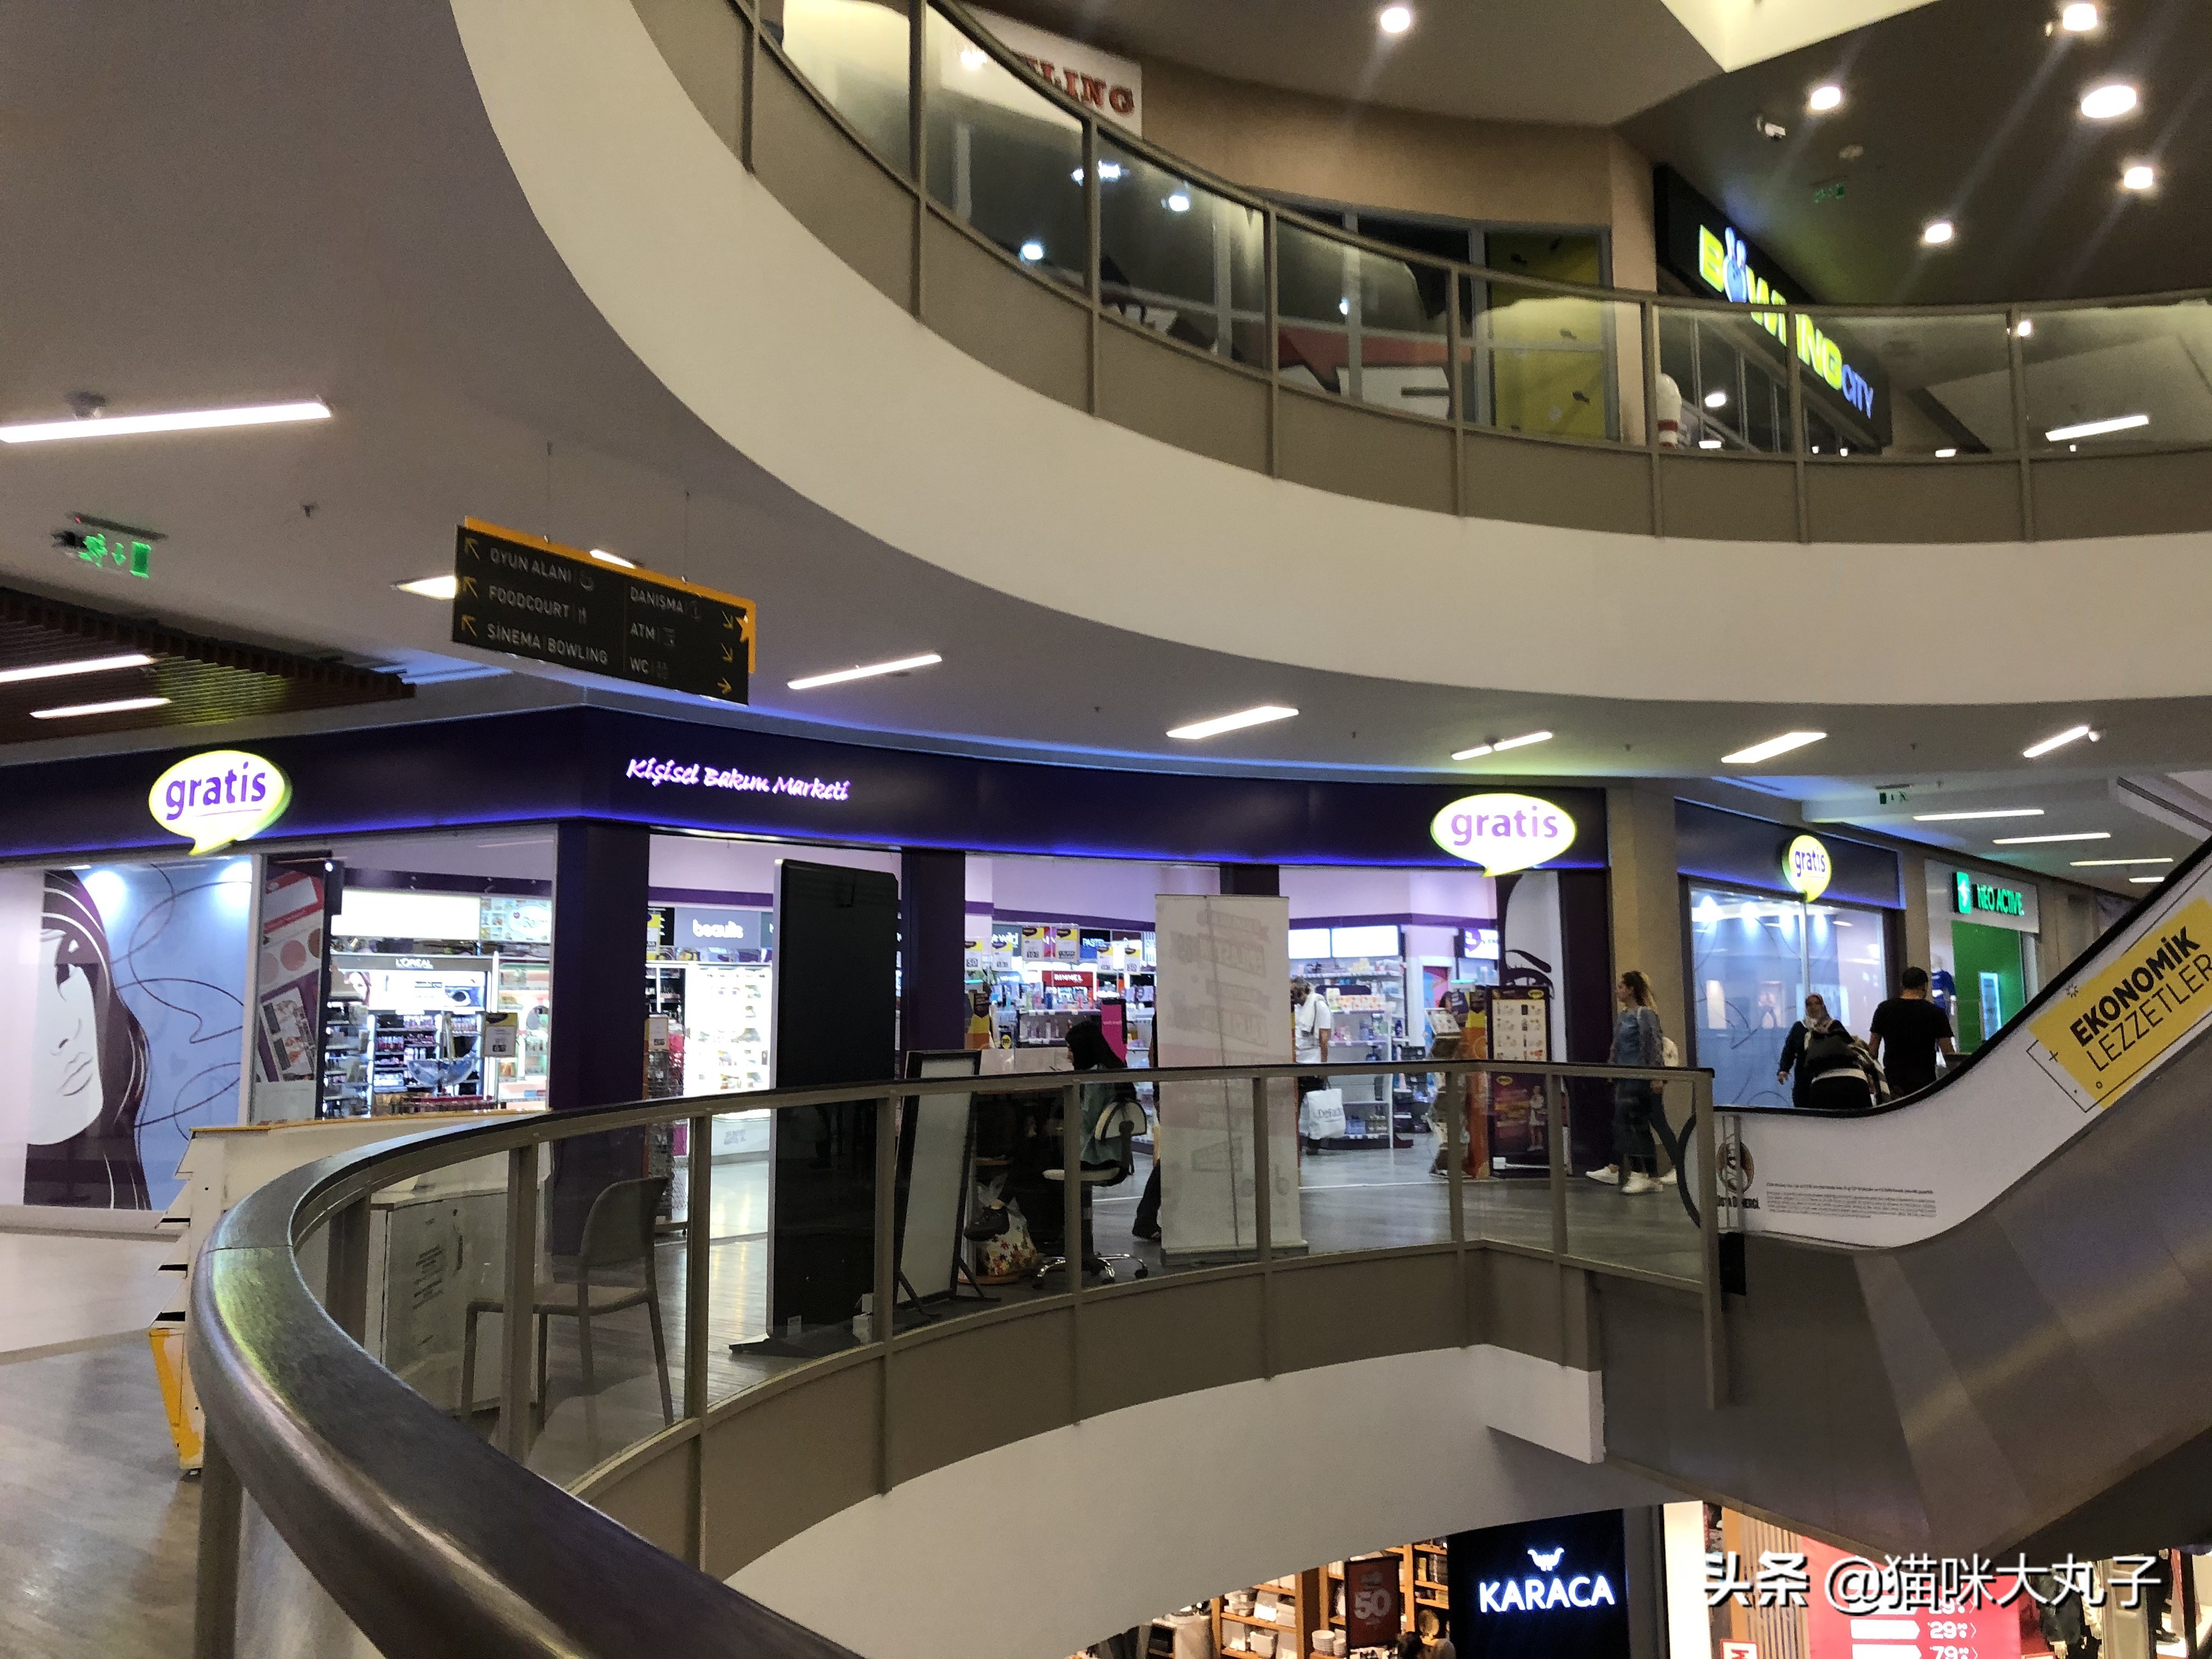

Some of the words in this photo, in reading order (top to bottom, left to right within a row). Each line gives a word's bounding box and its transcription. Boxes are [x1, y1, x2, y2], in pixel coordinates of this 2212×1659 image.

[1842, 364, 1875, 419] CITY
[490, 548, 529, 572] OYUN
[531, 560, 572, 584] ALANI
[489, 585, 569, 618] FOODCOURT
[487, 620, 541, 650] SİNEMA
[548, 637, 608, 665] BOWLING
[630, 622, 656, 641] ATM
[630, 657, 649, 675] WC
[166, 761, 266, 821] gratis
[1451, 805, 1558, 846] gratis
[1795, 845, 1826, 878] gratis
[1977, 883, 1995, 911] NEO
[2070, 926, 2200, 1047] EKONOMİK
[2086, 953, 2212, 1072] LEZZETLER
[1479, 1575, 1615, 1613] KARACA
